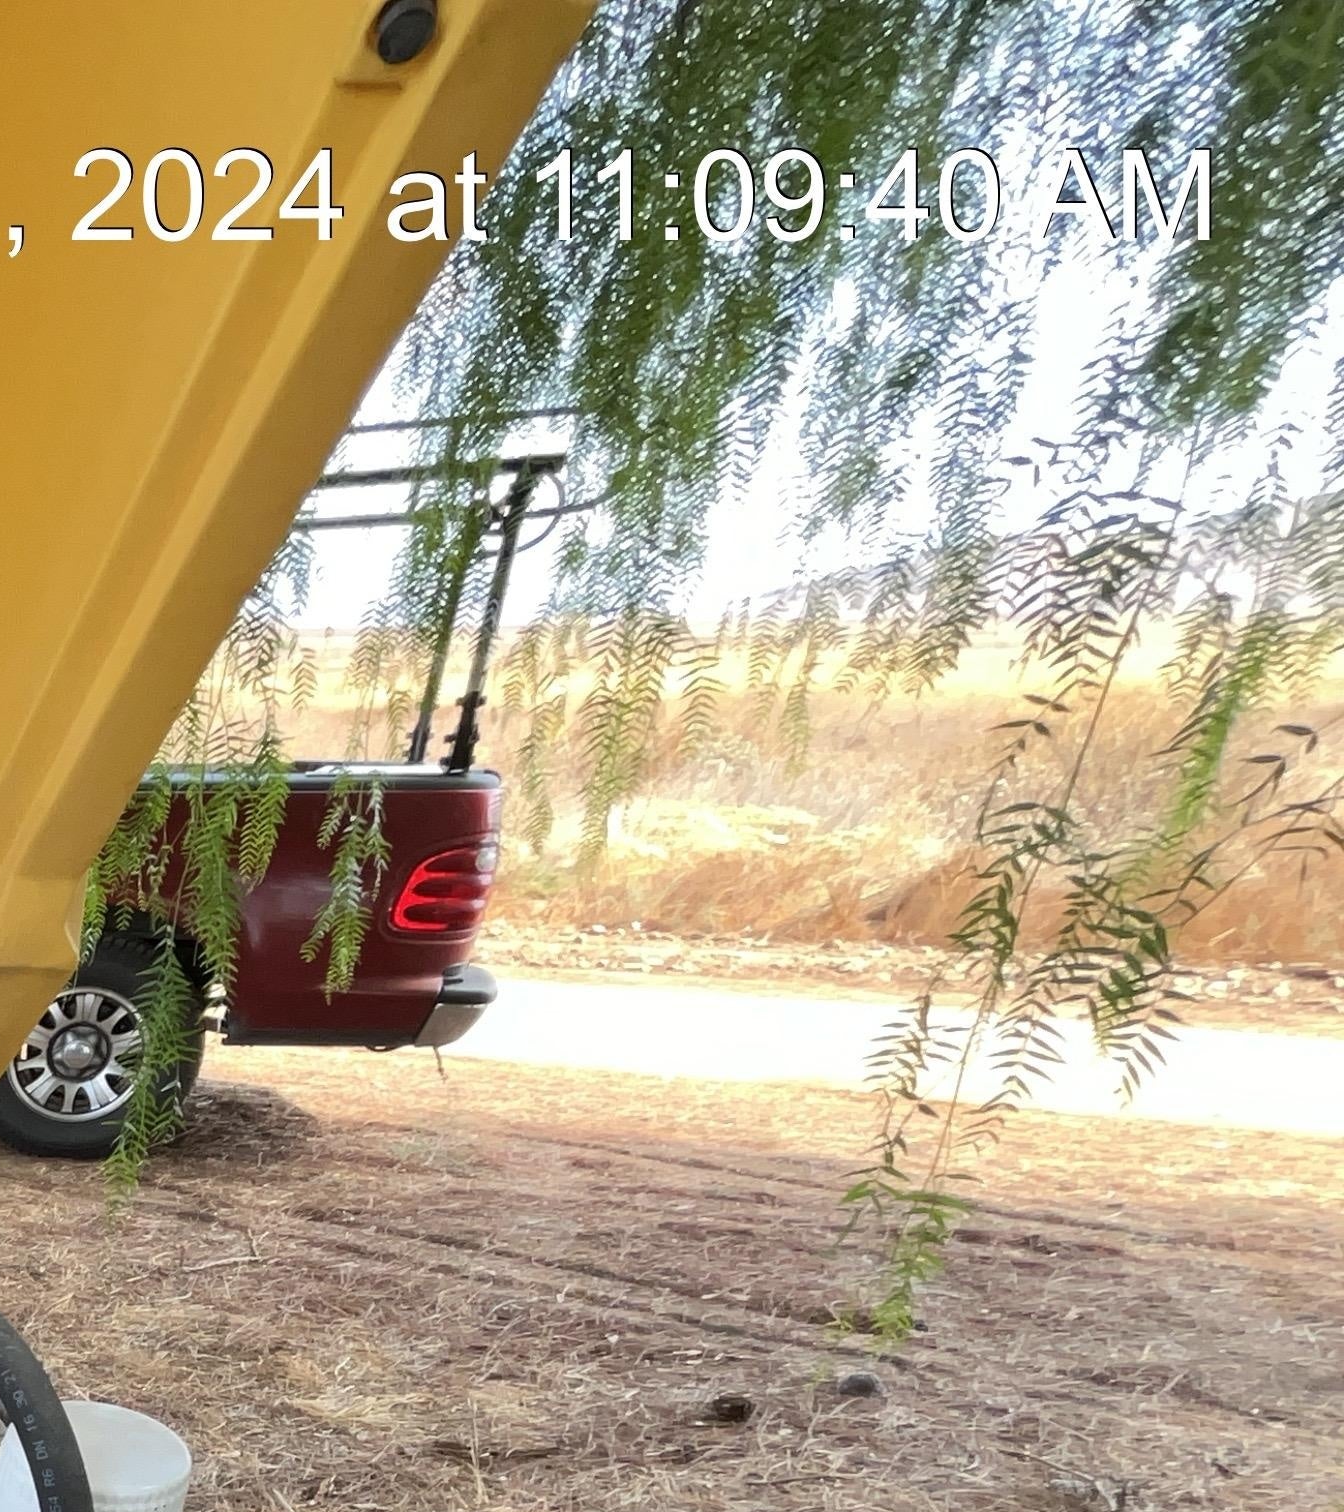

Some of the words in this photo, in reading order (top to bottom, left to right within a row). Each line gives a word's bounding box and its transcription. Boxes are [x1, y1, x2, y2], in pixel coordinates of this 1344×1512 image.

[23, 1414, 37, 1432] 16
[32, 1439, 49, 1461] DN
[42, 1469, 56, 1488] R6
